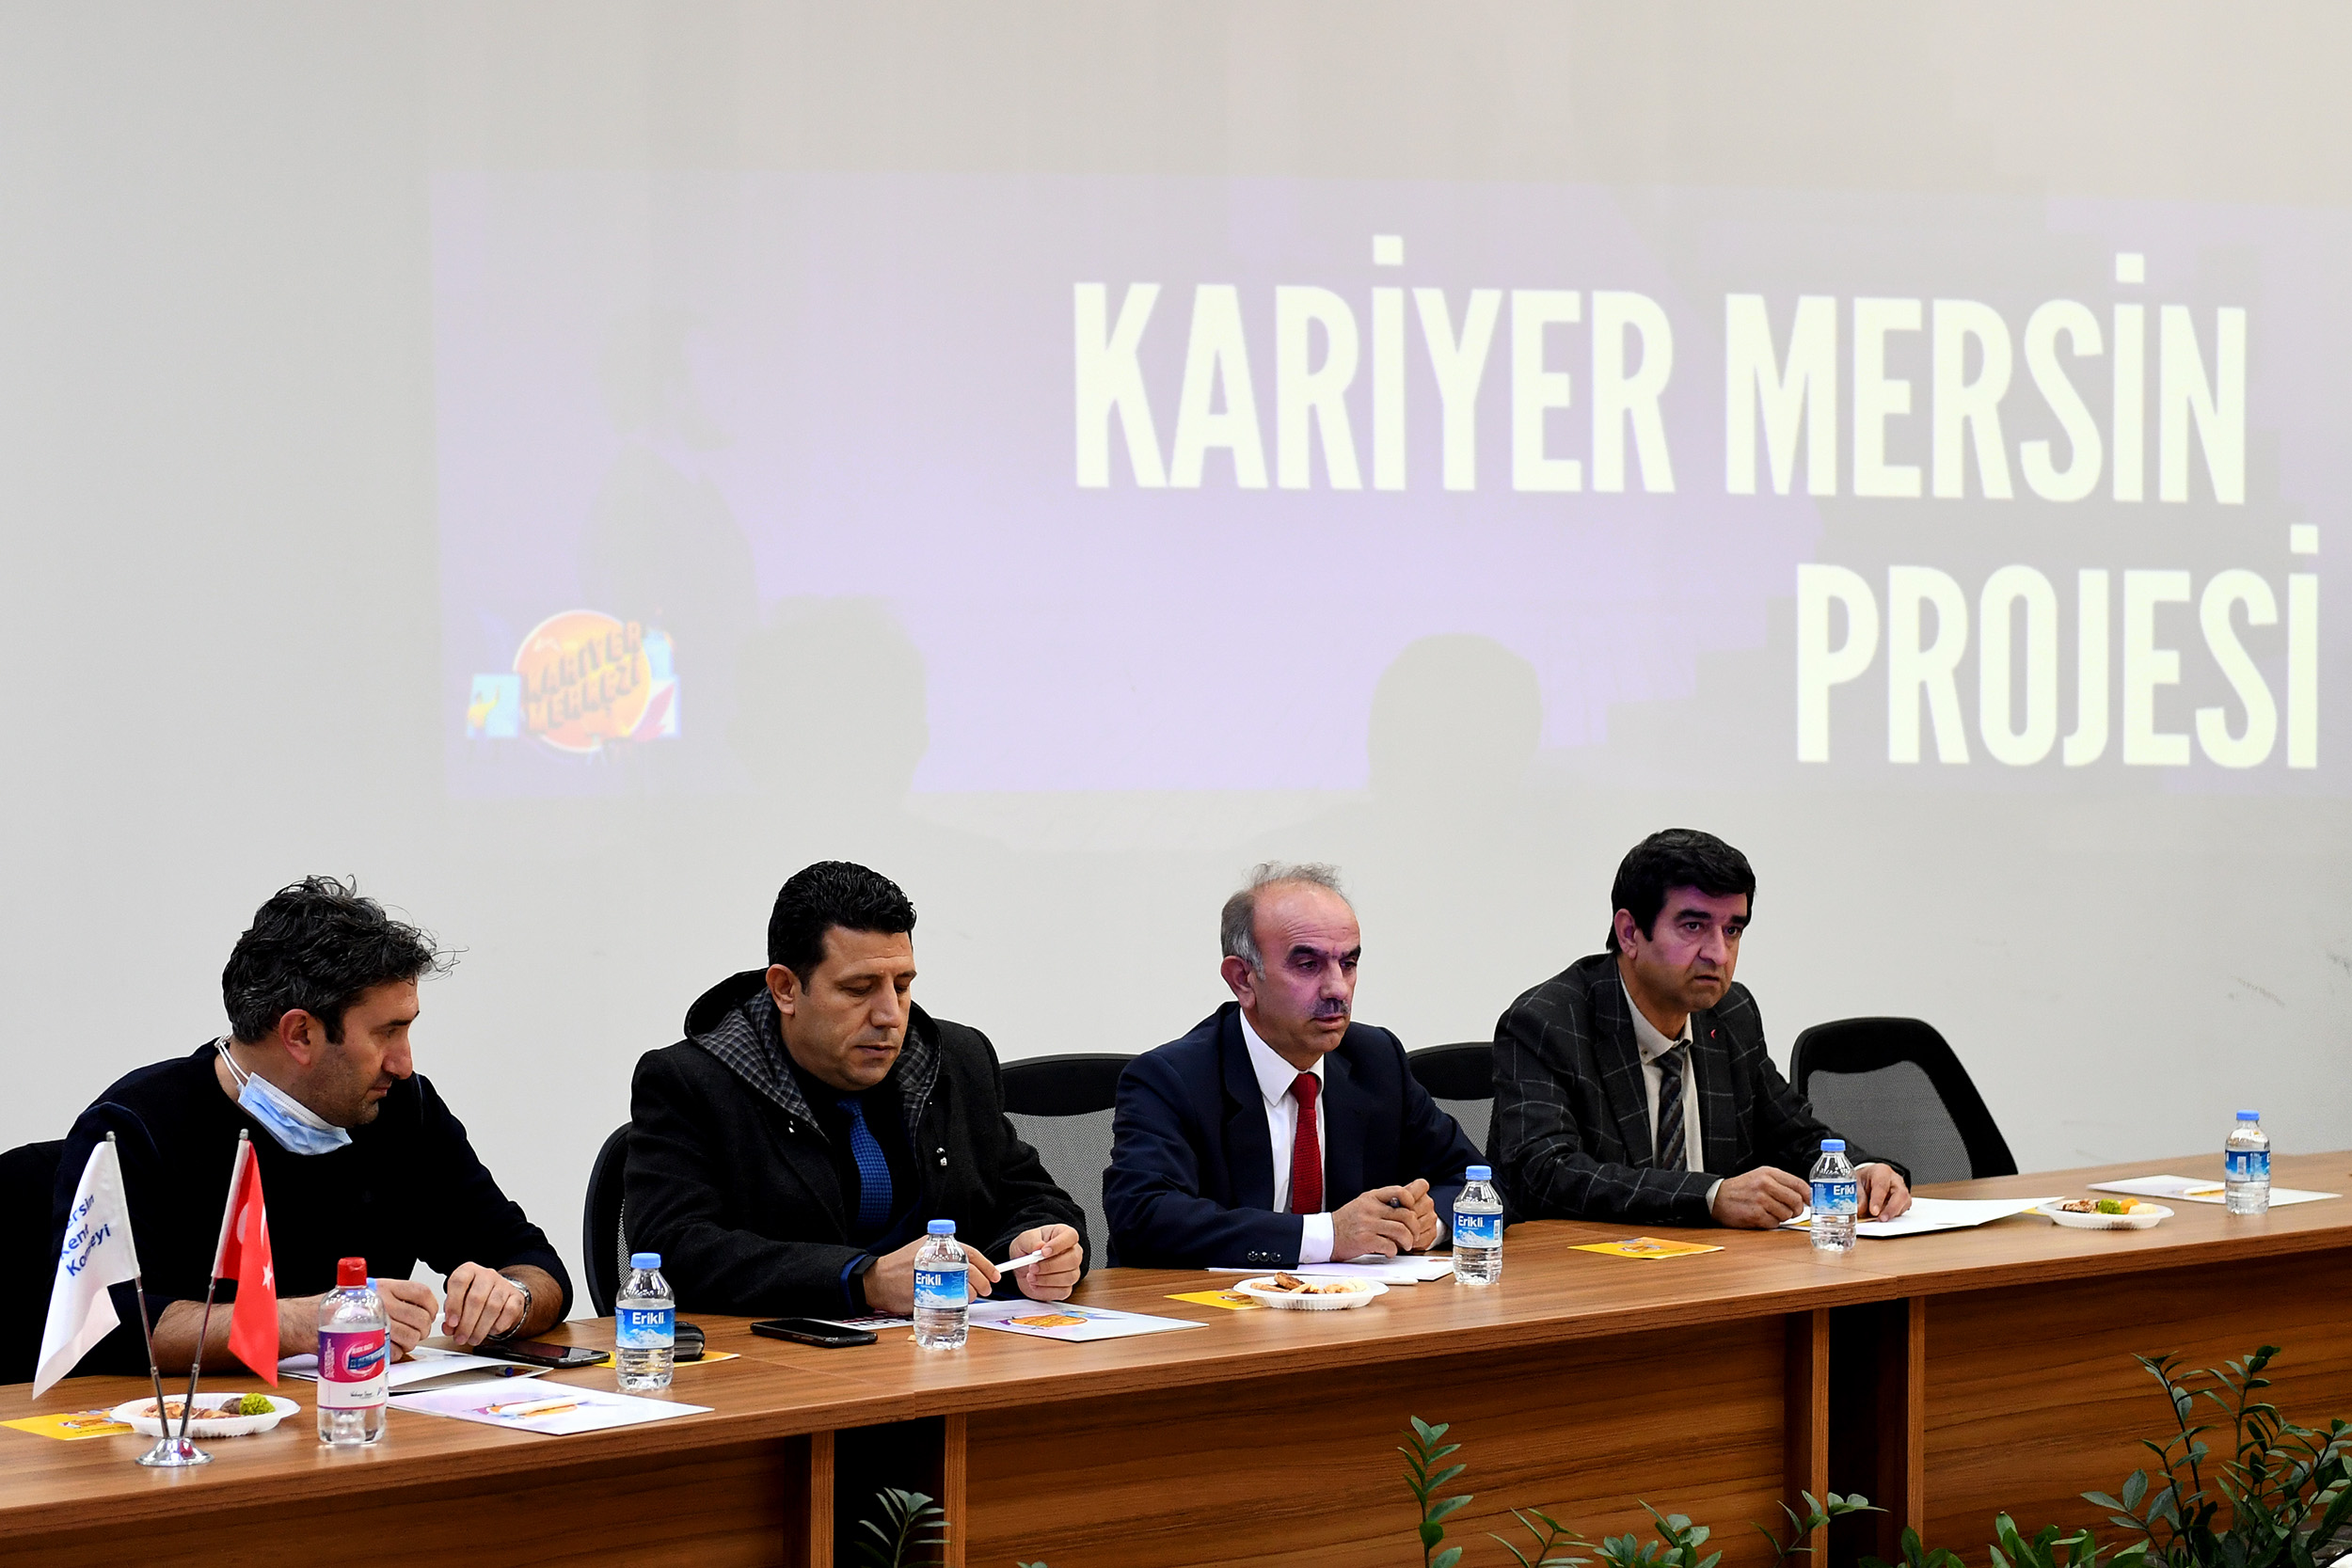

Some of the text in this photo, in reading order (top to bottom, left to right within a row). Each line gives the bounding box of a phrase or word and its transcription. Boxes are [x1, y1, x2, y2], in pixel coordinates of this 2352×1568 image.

[1073, 234, 2249, 505] KARİYER MERSİN
[1796, 523, 2320, 768] PROJESİ
[66, 1195, 95, 1229] ersin
[1458, 1215, 1484, 1227] Erikli
[66, 1224, 111, 1276] Koeyi
[915, 1272, 942, 1286] Erikli
[632, 1311, 664, 1324] Erikli
